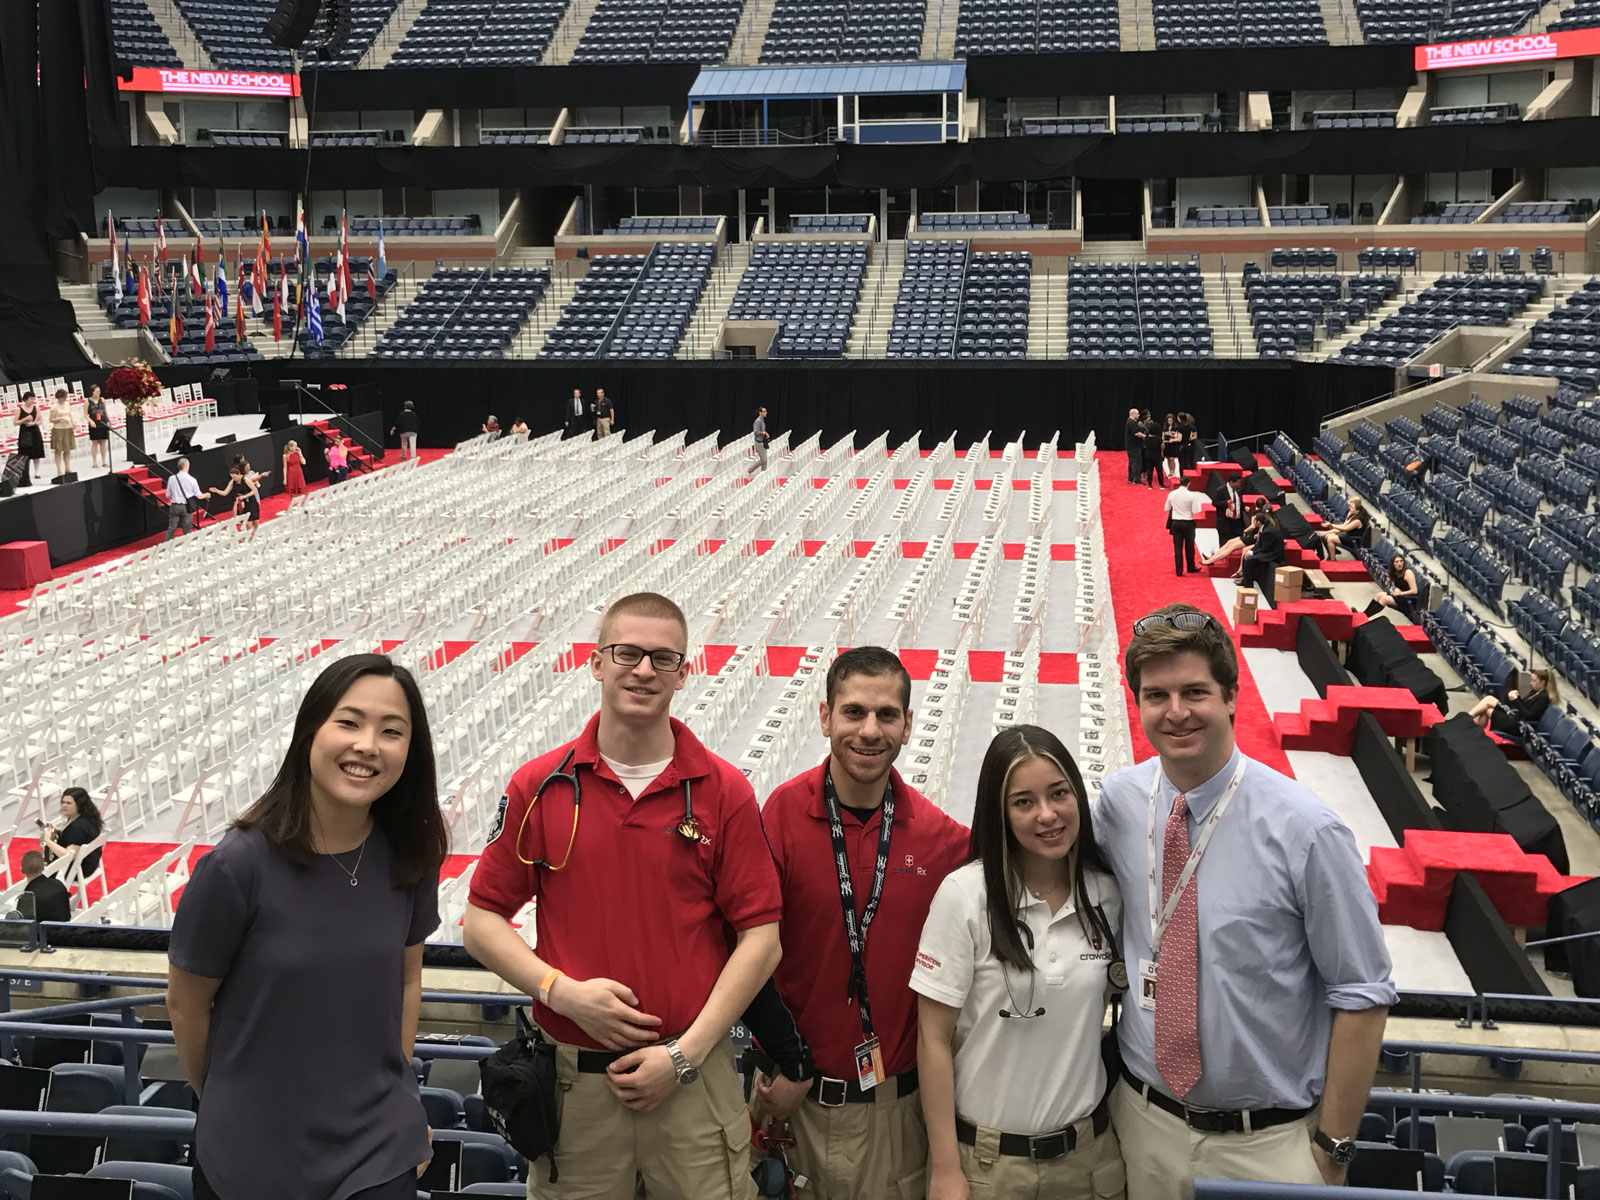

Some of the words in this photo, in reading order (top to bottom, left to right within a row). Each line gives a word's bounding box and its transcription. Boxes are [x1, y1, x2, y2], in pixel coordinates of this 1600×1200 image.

[1425, 46, 1453, 60] THE
[1454, 41, 1493, 57] NEW
[1494, 36, 1558, 53] SCHOOL
[159, 70, 189, 84] THE
[191, 71, 229, 85] NEW
[231, 73, 291, 87] SCHOOL
